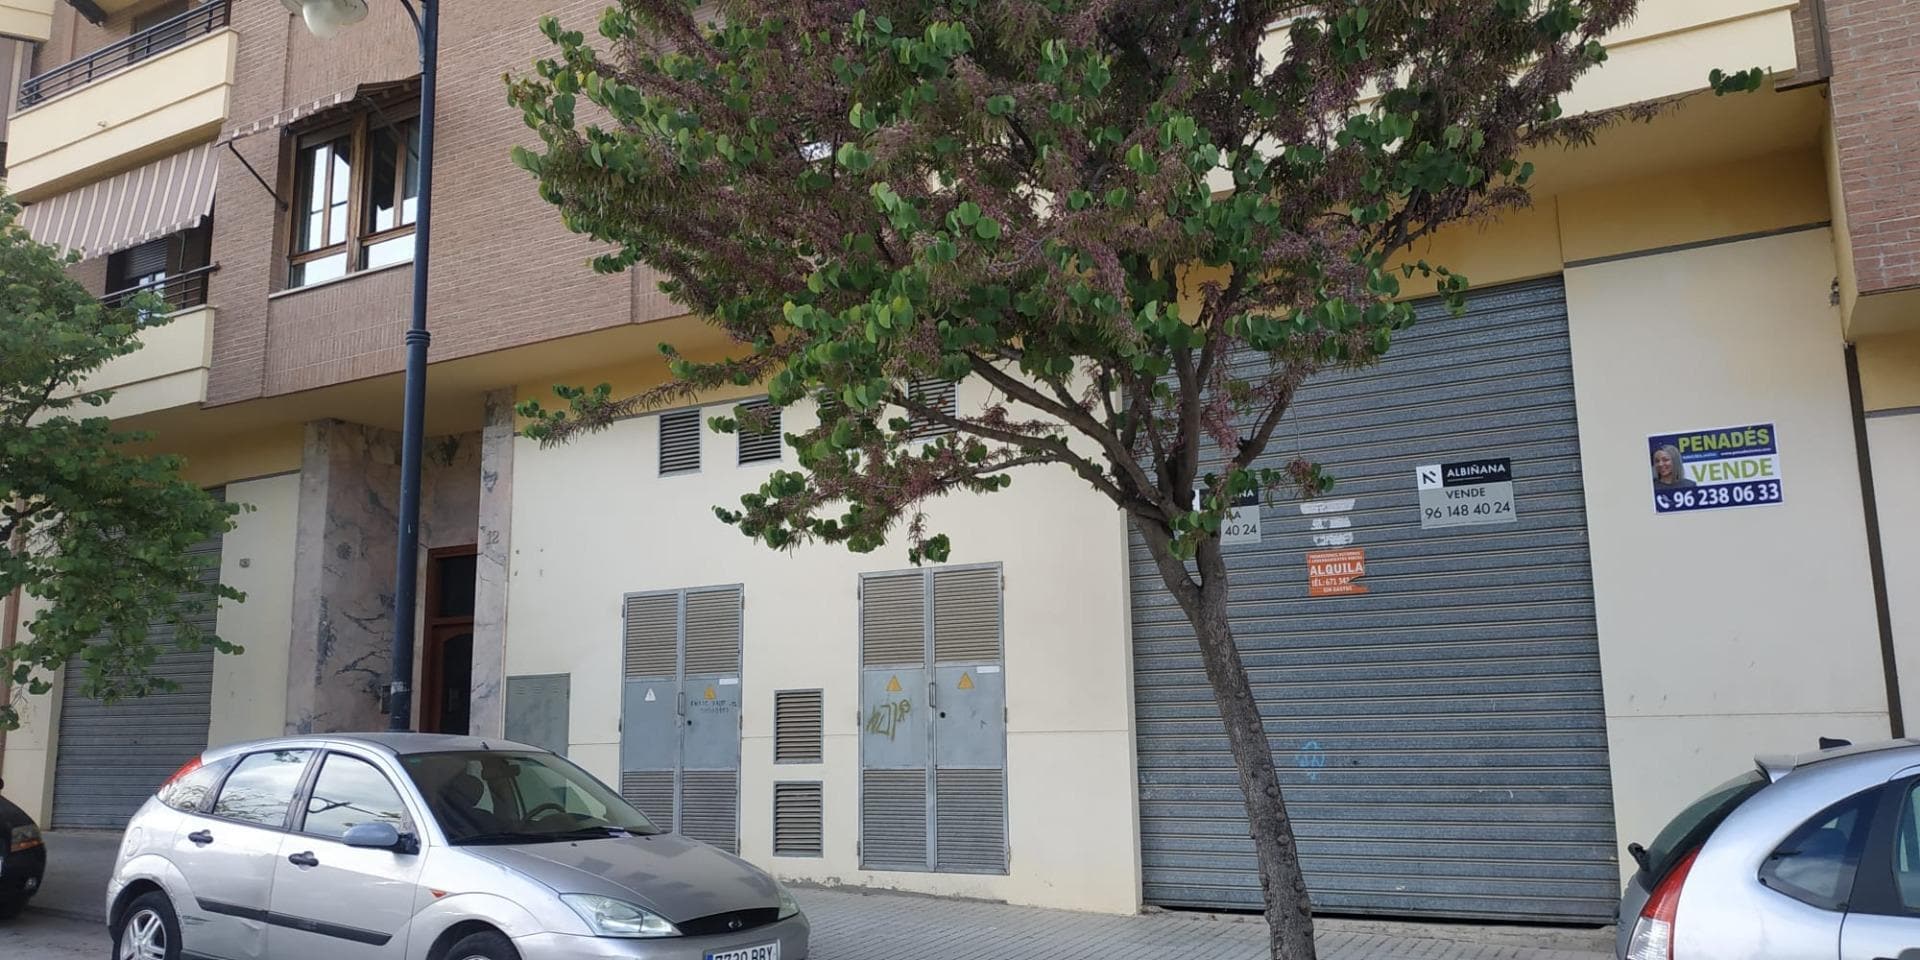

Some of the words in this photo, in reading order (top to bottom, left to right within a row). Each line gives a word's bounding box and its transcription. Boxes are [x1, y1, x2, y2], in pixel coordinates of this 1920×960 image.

[1678, 426, 1770, 452] PENADÉS
[1447, 463, 1506, 478] ALBIÑANA
[1691, 458, 1774, 482] VENDE
[1446, 487, 1486, 499] VENDE
[1673, 491, 1695, 508] 96
[1698, 488, 1730, 505] 238
[1733, 485, 1754, 503] 06
[1758, 483, 1779, 500] 33
[1425, 507, 1442, 519] 96
[1447, 504, 1469, 517] 148
[1473, 502, 1491, 515] 40
[1494, 501, 1511, 514] 24
[486, 530, 499, 544] 12
[1225, 525, 1240, 536] 40
[1242, 524, 1257, 535] 24
[1310, 562, 1364, 576] ALQUILA
